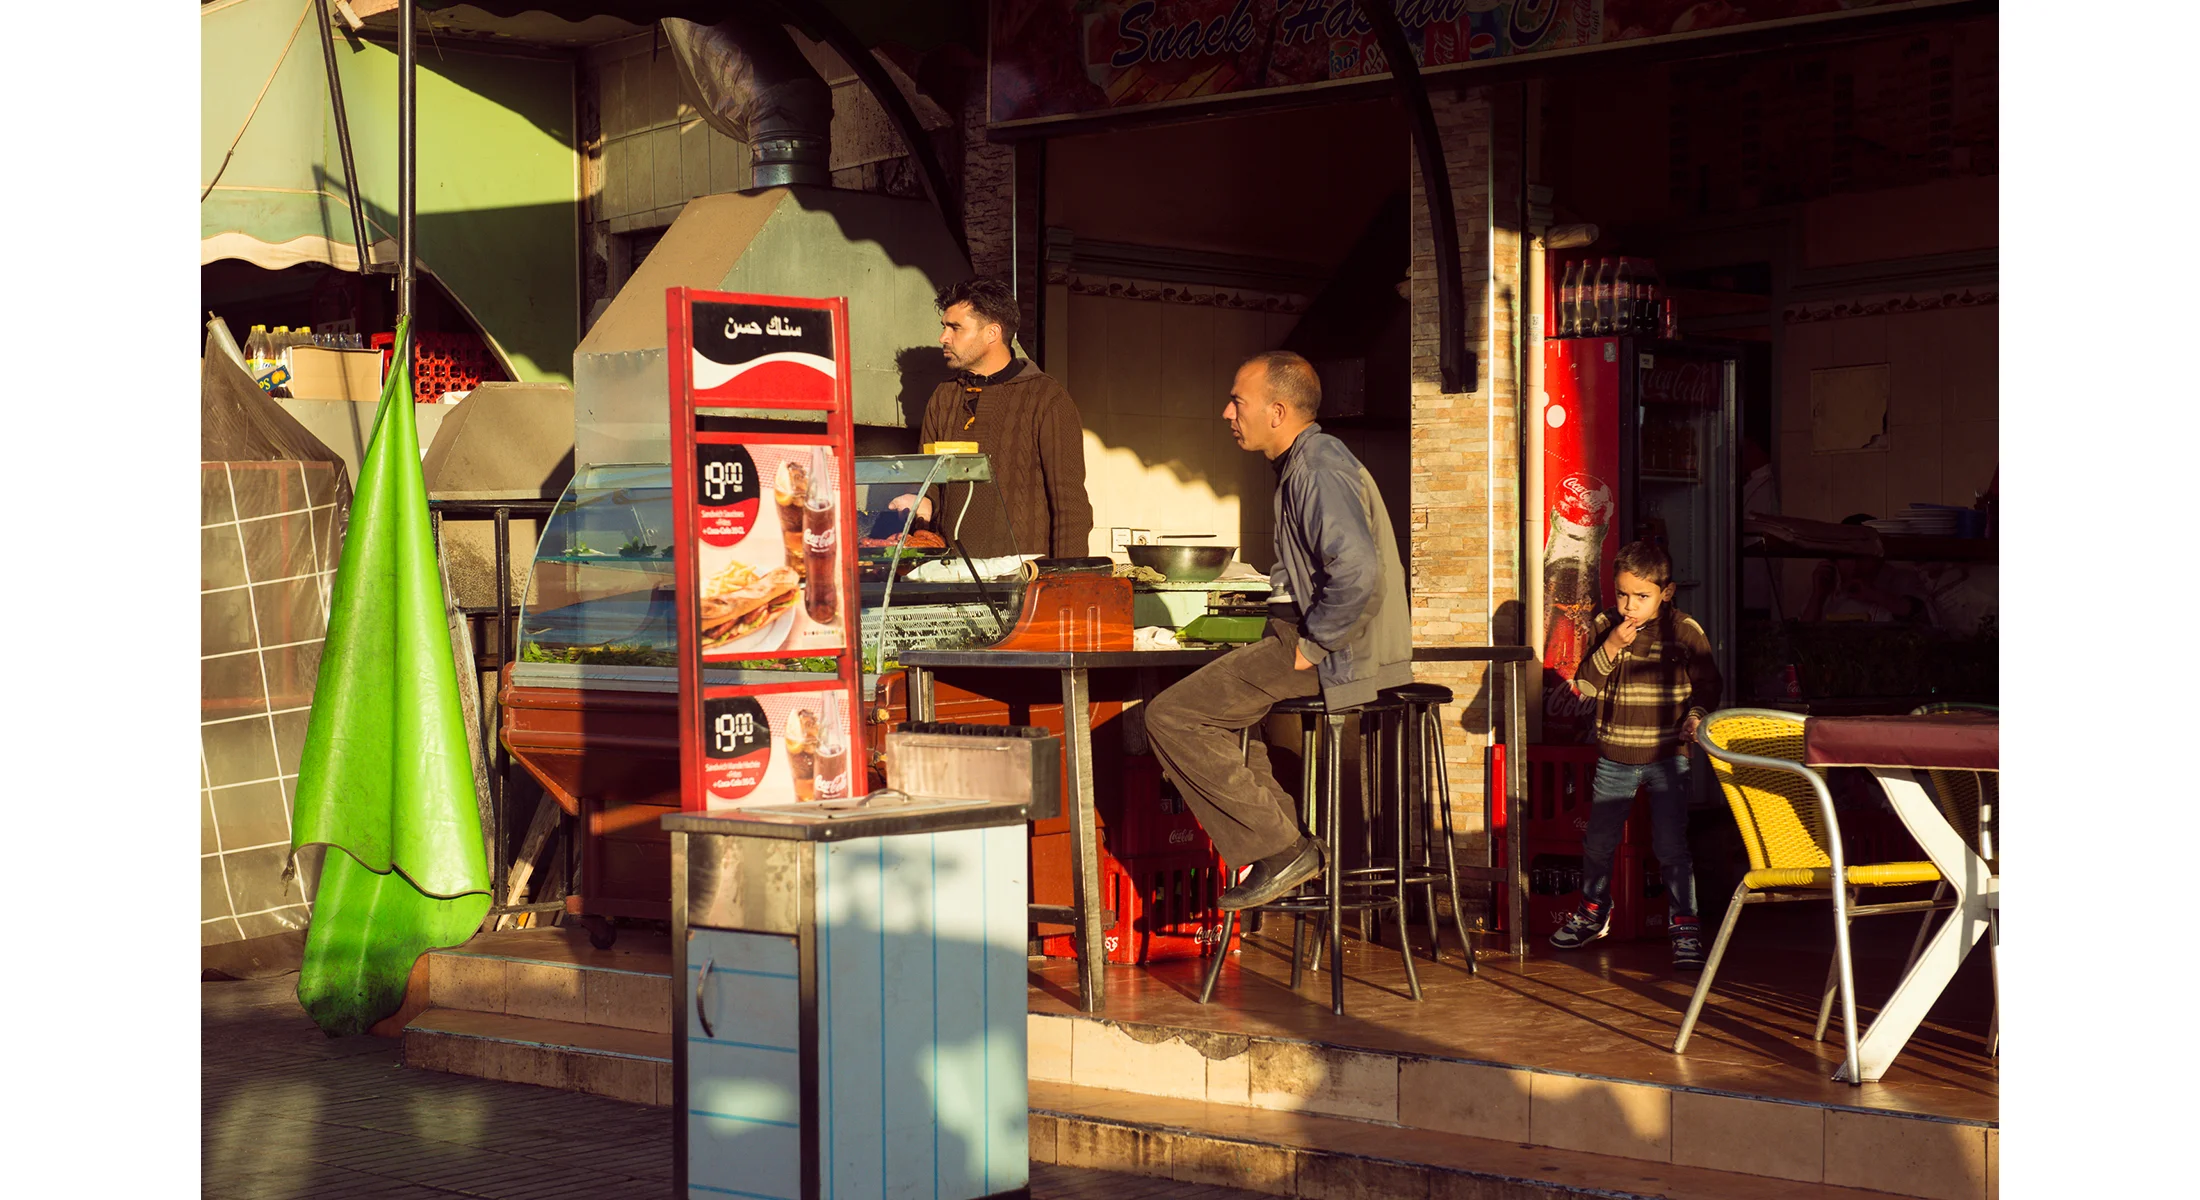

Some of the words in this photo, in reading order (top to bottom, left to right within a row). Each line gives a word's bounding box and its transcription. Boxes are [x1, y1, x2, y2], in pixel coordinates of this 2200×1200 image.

[1110, 0, 1256, 68] Snack
[1277, 0, 1466, 47] Hasan
[724, 317, 762, 340] حسن
[765, 315, 802, 337] سناك
